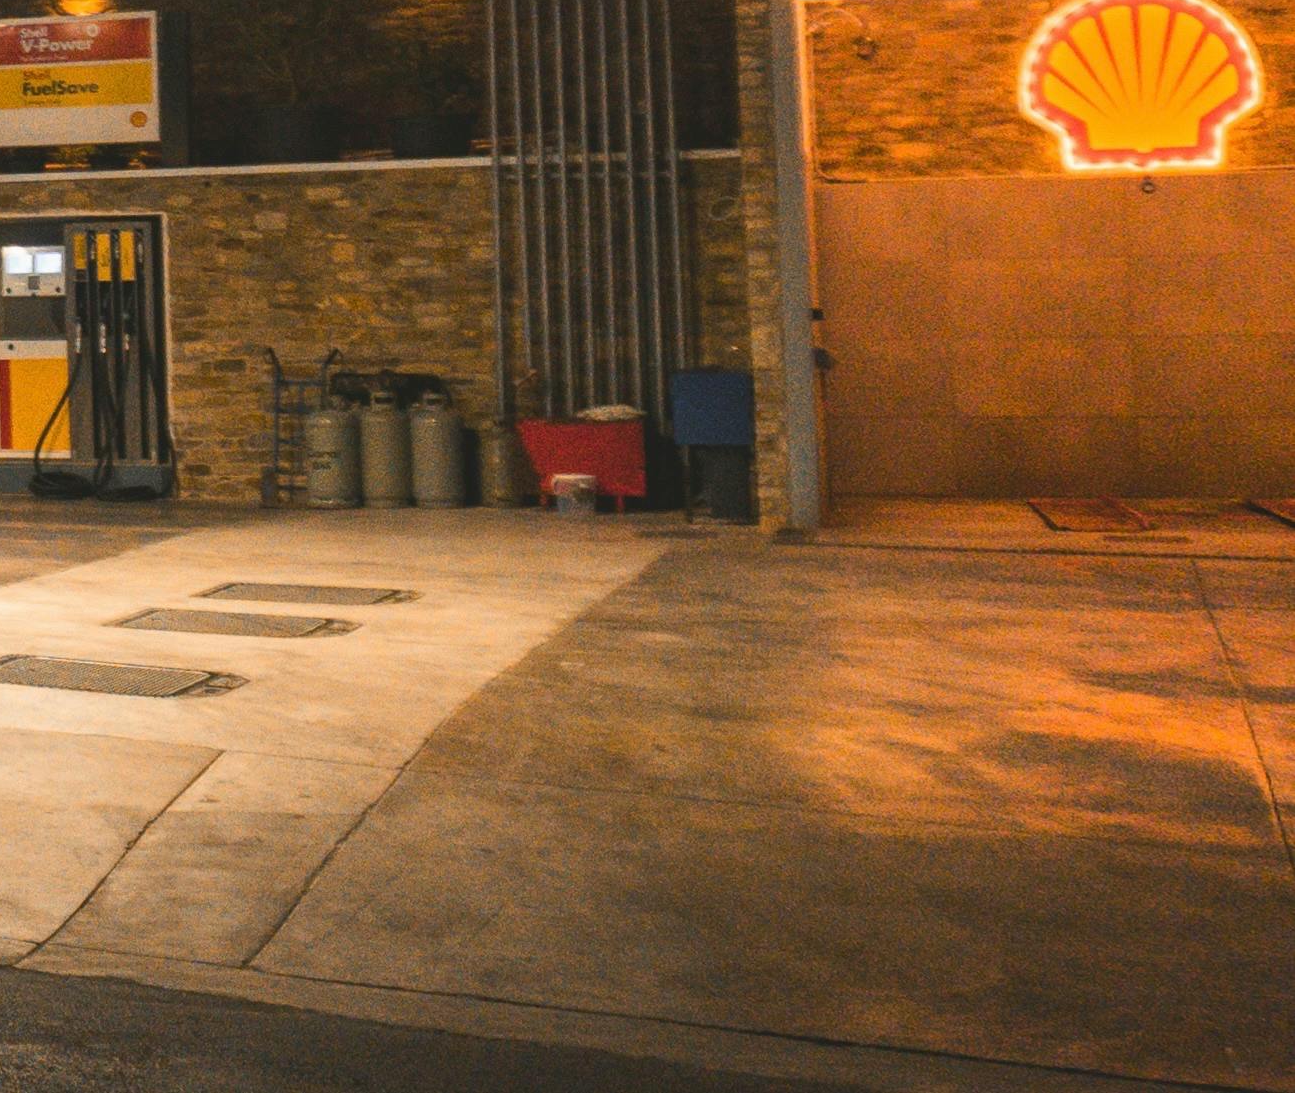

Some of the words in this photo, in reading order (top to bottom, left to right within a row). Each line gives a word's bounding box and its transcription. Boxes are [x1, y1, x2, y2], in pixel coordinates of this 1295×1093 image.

[20, 27, 48, 38] Shell
[21, 39, 93, 53] V-Power
[23, 81, 99, 96] FuelSave
